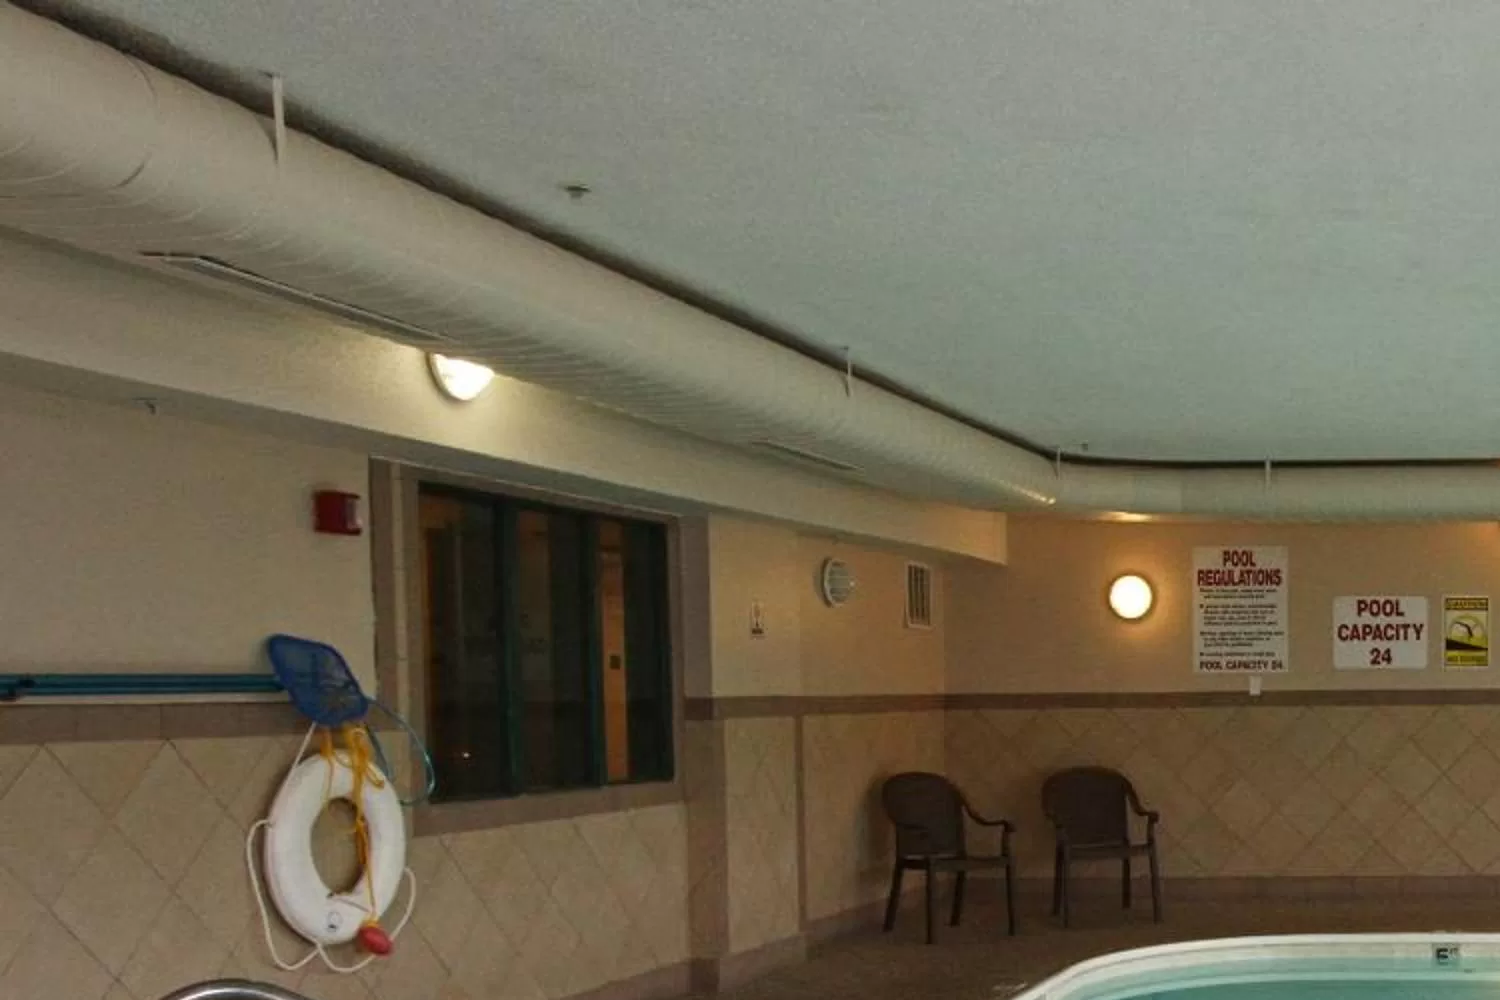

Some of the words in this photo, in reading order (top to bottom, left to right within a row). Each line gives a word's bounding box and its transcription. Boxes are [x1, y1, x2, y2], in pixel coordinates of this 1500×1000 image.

[1223, 550, 1256, 567] POOL
[1197, 569, 1282, 586] REGULATIONS
[1357, 600, 1404, 616] POOL
[1338, 623, 1424, 640] CAPACITY
[1370, 648, 1392, 664] 24
